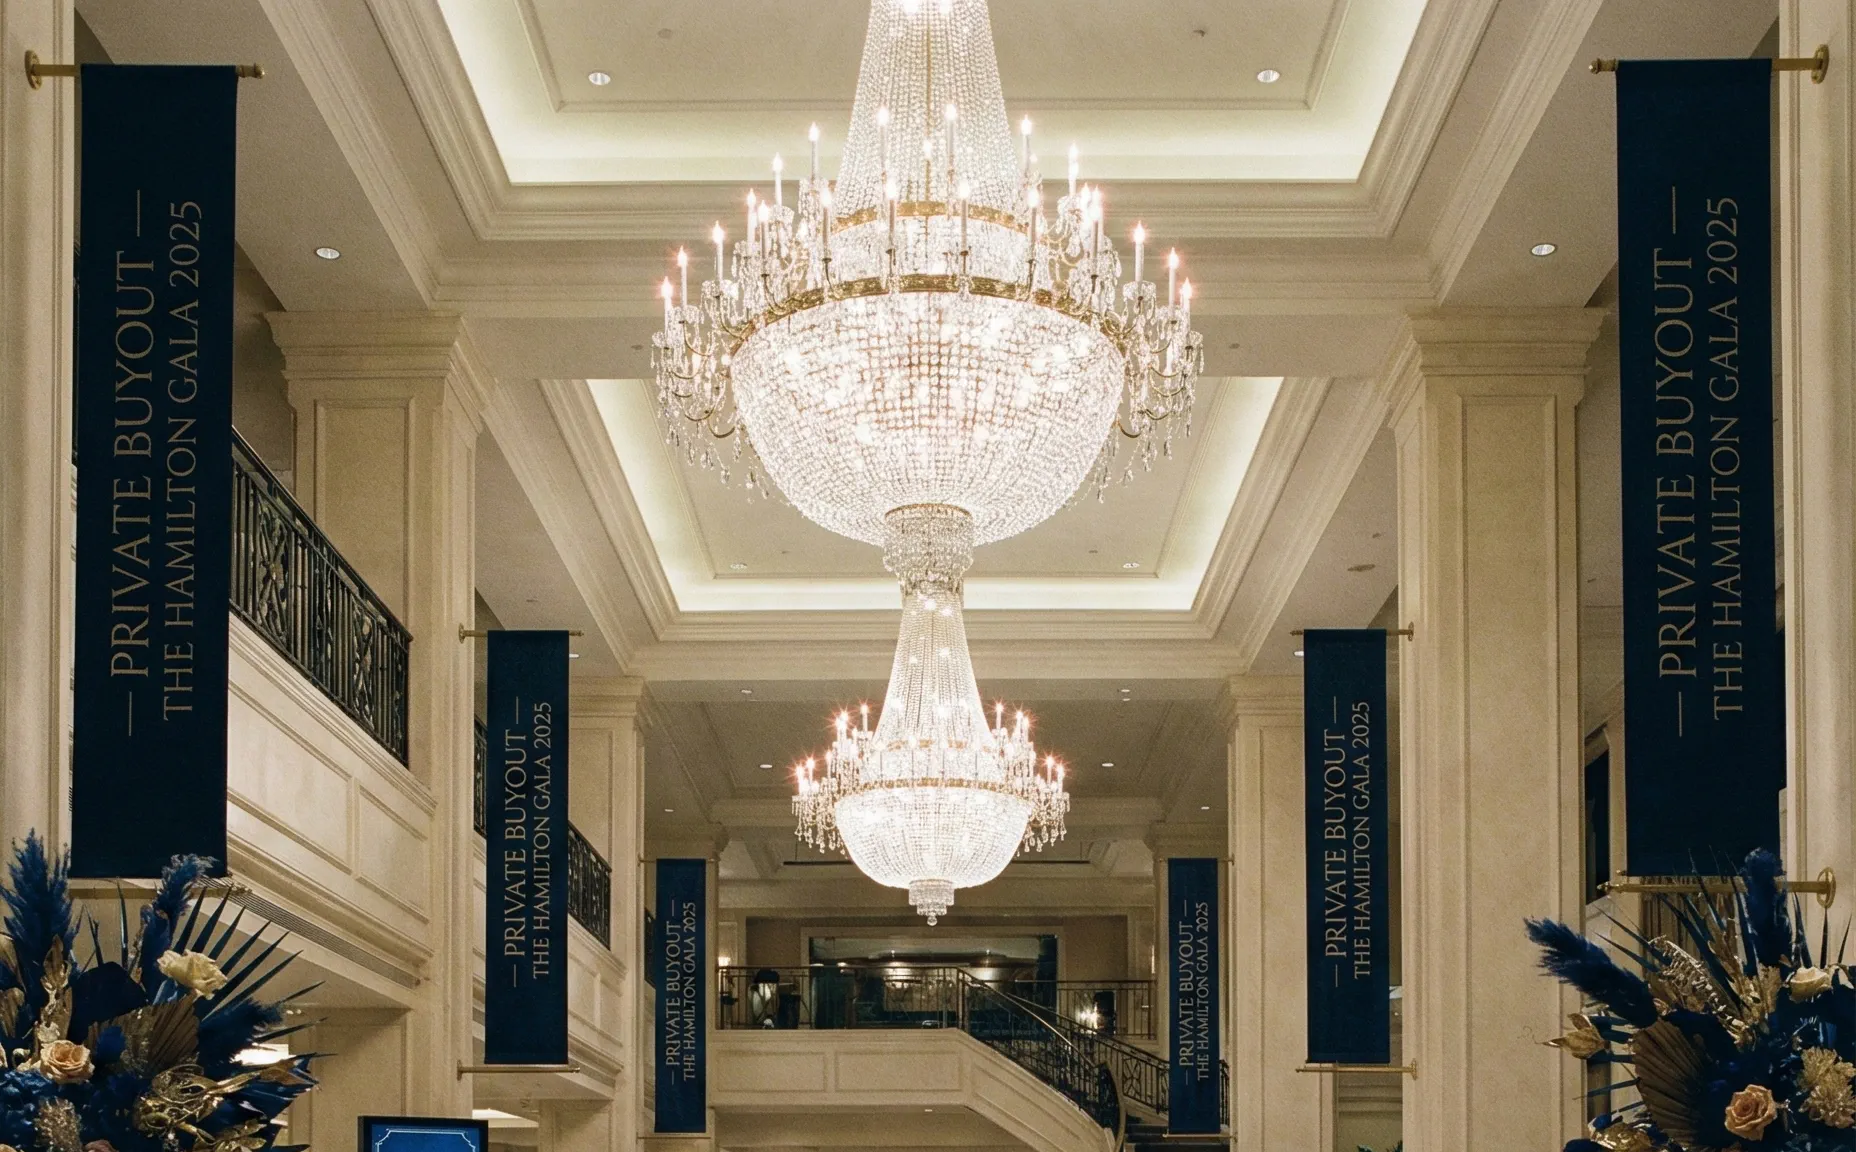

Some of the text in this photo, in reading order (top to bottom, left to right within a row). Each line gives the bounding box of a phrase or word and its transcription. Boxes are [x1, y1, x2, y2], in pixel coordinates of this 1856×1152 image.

[111, 250, 154, 677] PRIVATE BUYOUT
[164, 201, 201, 721] THE HAMILTON GALA 2025
[1654, 247, 1696, 678] PRIVATE BUYOUT
[1707, 197, 1743, 721] THE HAMILTON GALA 2025
[505, 729, 526, 956] PRIVATE BUYOUT
[533, 702, 551, 979] THE HAMILTON GALA 2025
[1324, 728, 1346, 957] PRIVATE BUYOUT
[1352, 701, 1370, 979] THE HAMILTON GALA 2025
[665, 920, 680, 1066] PRIVATE BUYOUT
[683, 902, 695, 1081] THE HAMILTON GALA 2025
[1179, 920, 1194, 1066] PRIVATE BUYOUT
[1196, 902, 1208, 1081] THE HAMILTON GALA 2025
